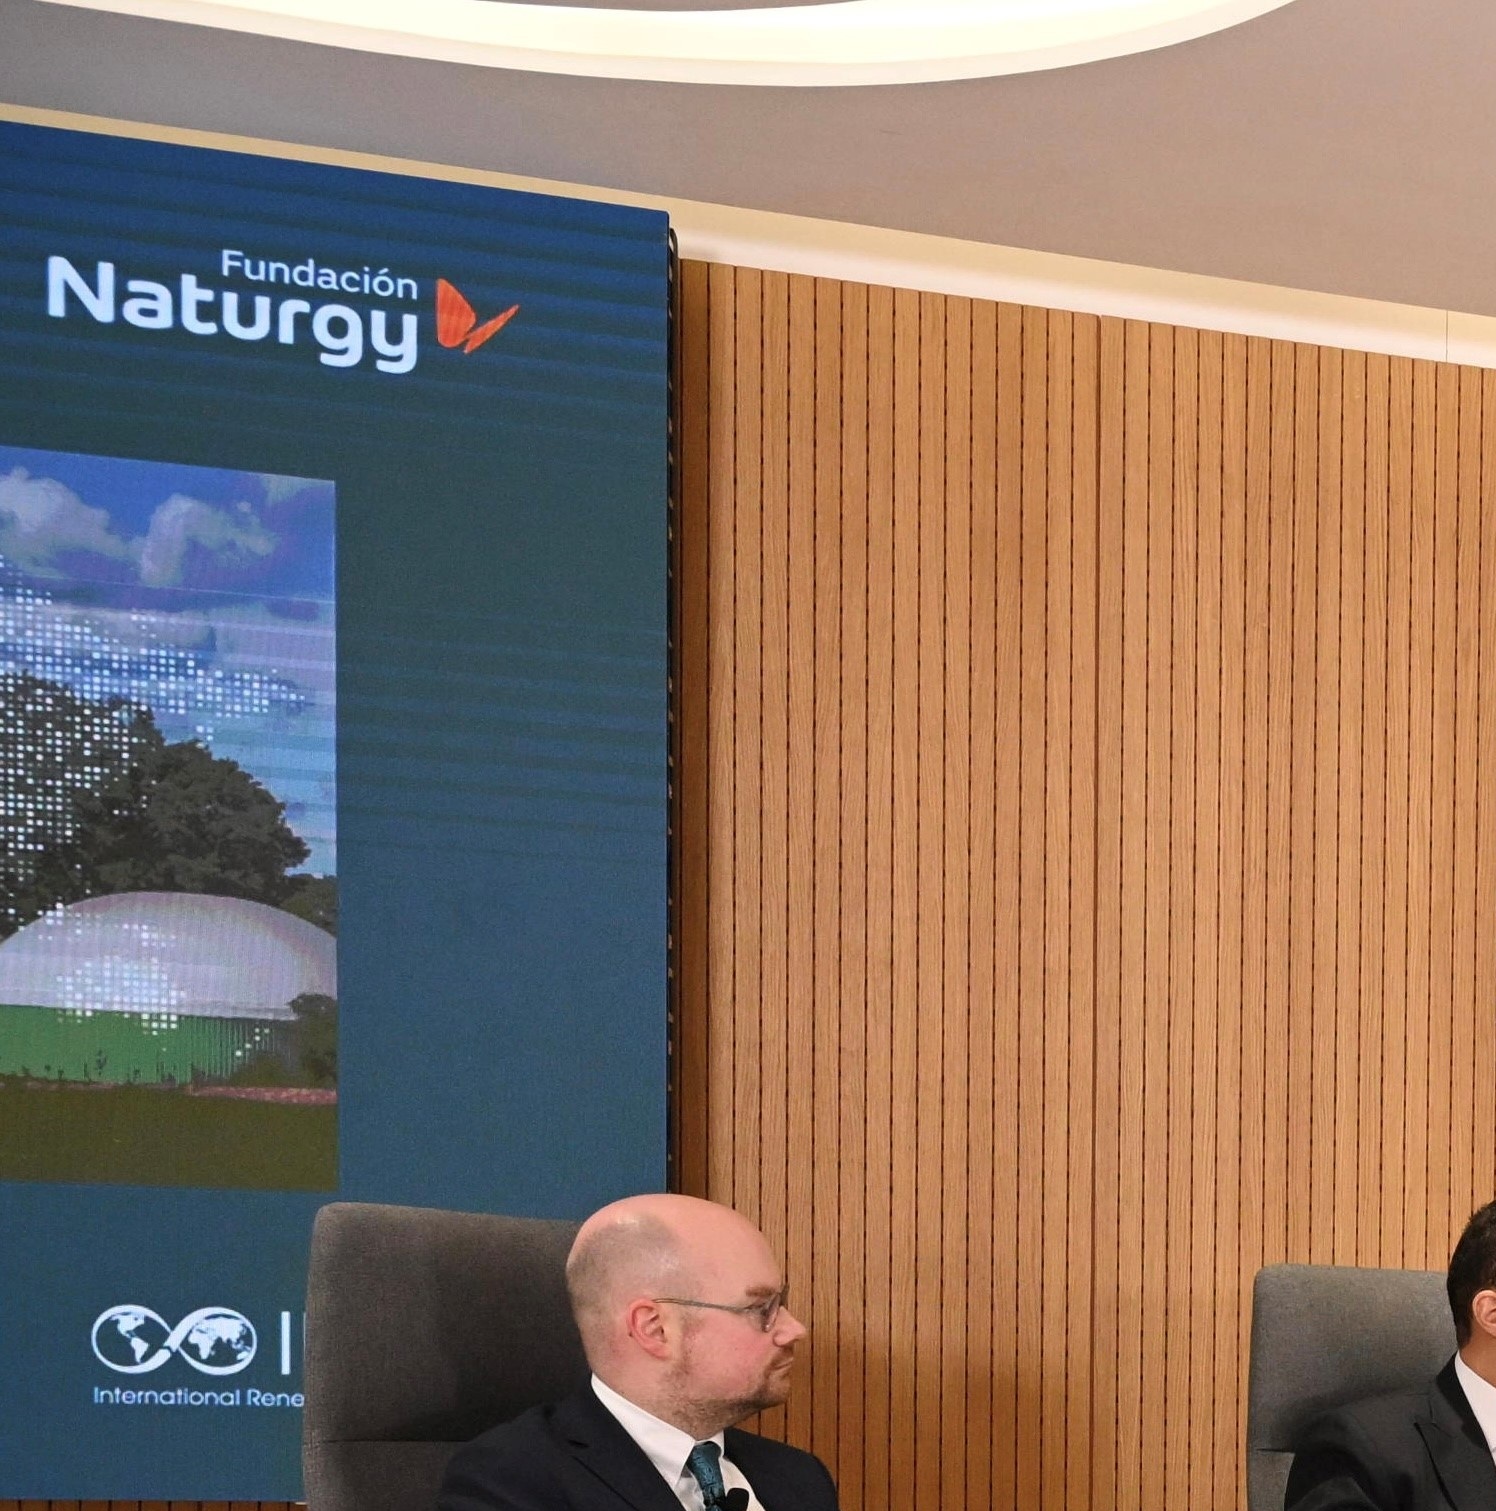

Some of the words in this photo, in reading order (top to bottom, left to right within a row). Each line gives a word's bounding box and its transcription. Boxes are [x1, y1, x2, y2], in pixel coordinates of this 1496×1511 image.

[221, 250, 418, 299] Fundación
[47, 255, 418, 374] Naturgy
[94, 1386, 240, 1406] International
[246, 1388, 304, 1408] Rene
